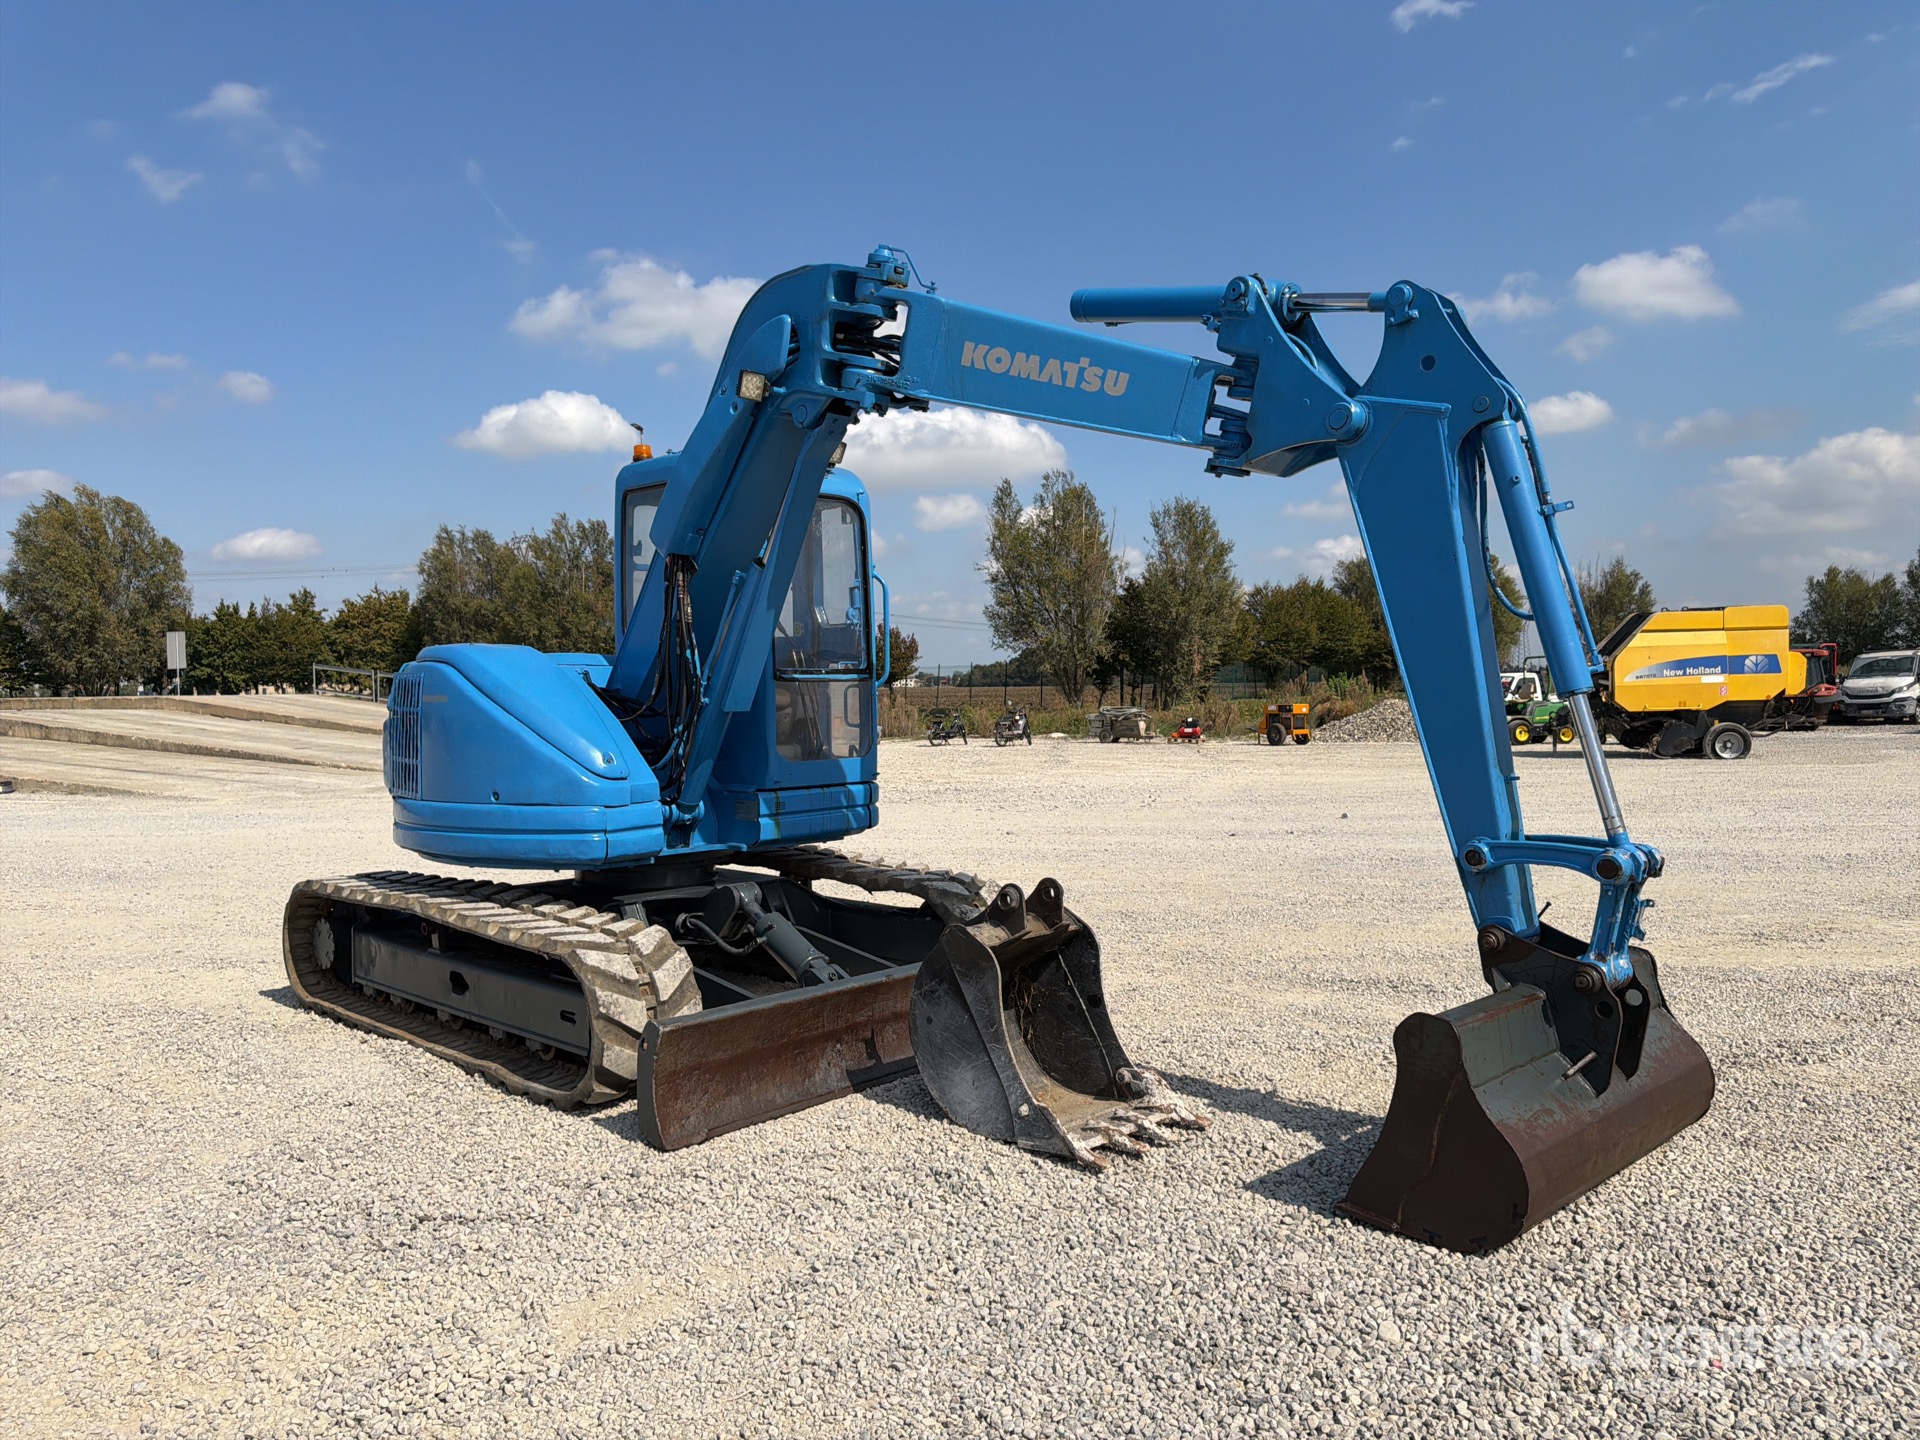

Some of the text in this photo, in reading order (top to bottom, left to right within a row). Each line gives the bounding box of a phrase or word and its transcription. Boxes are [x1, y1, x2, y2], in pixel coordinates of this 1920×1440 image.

[960, 341, 1130, 397] KOMATSU
[1663, 665, 1722, 677] New Holland
